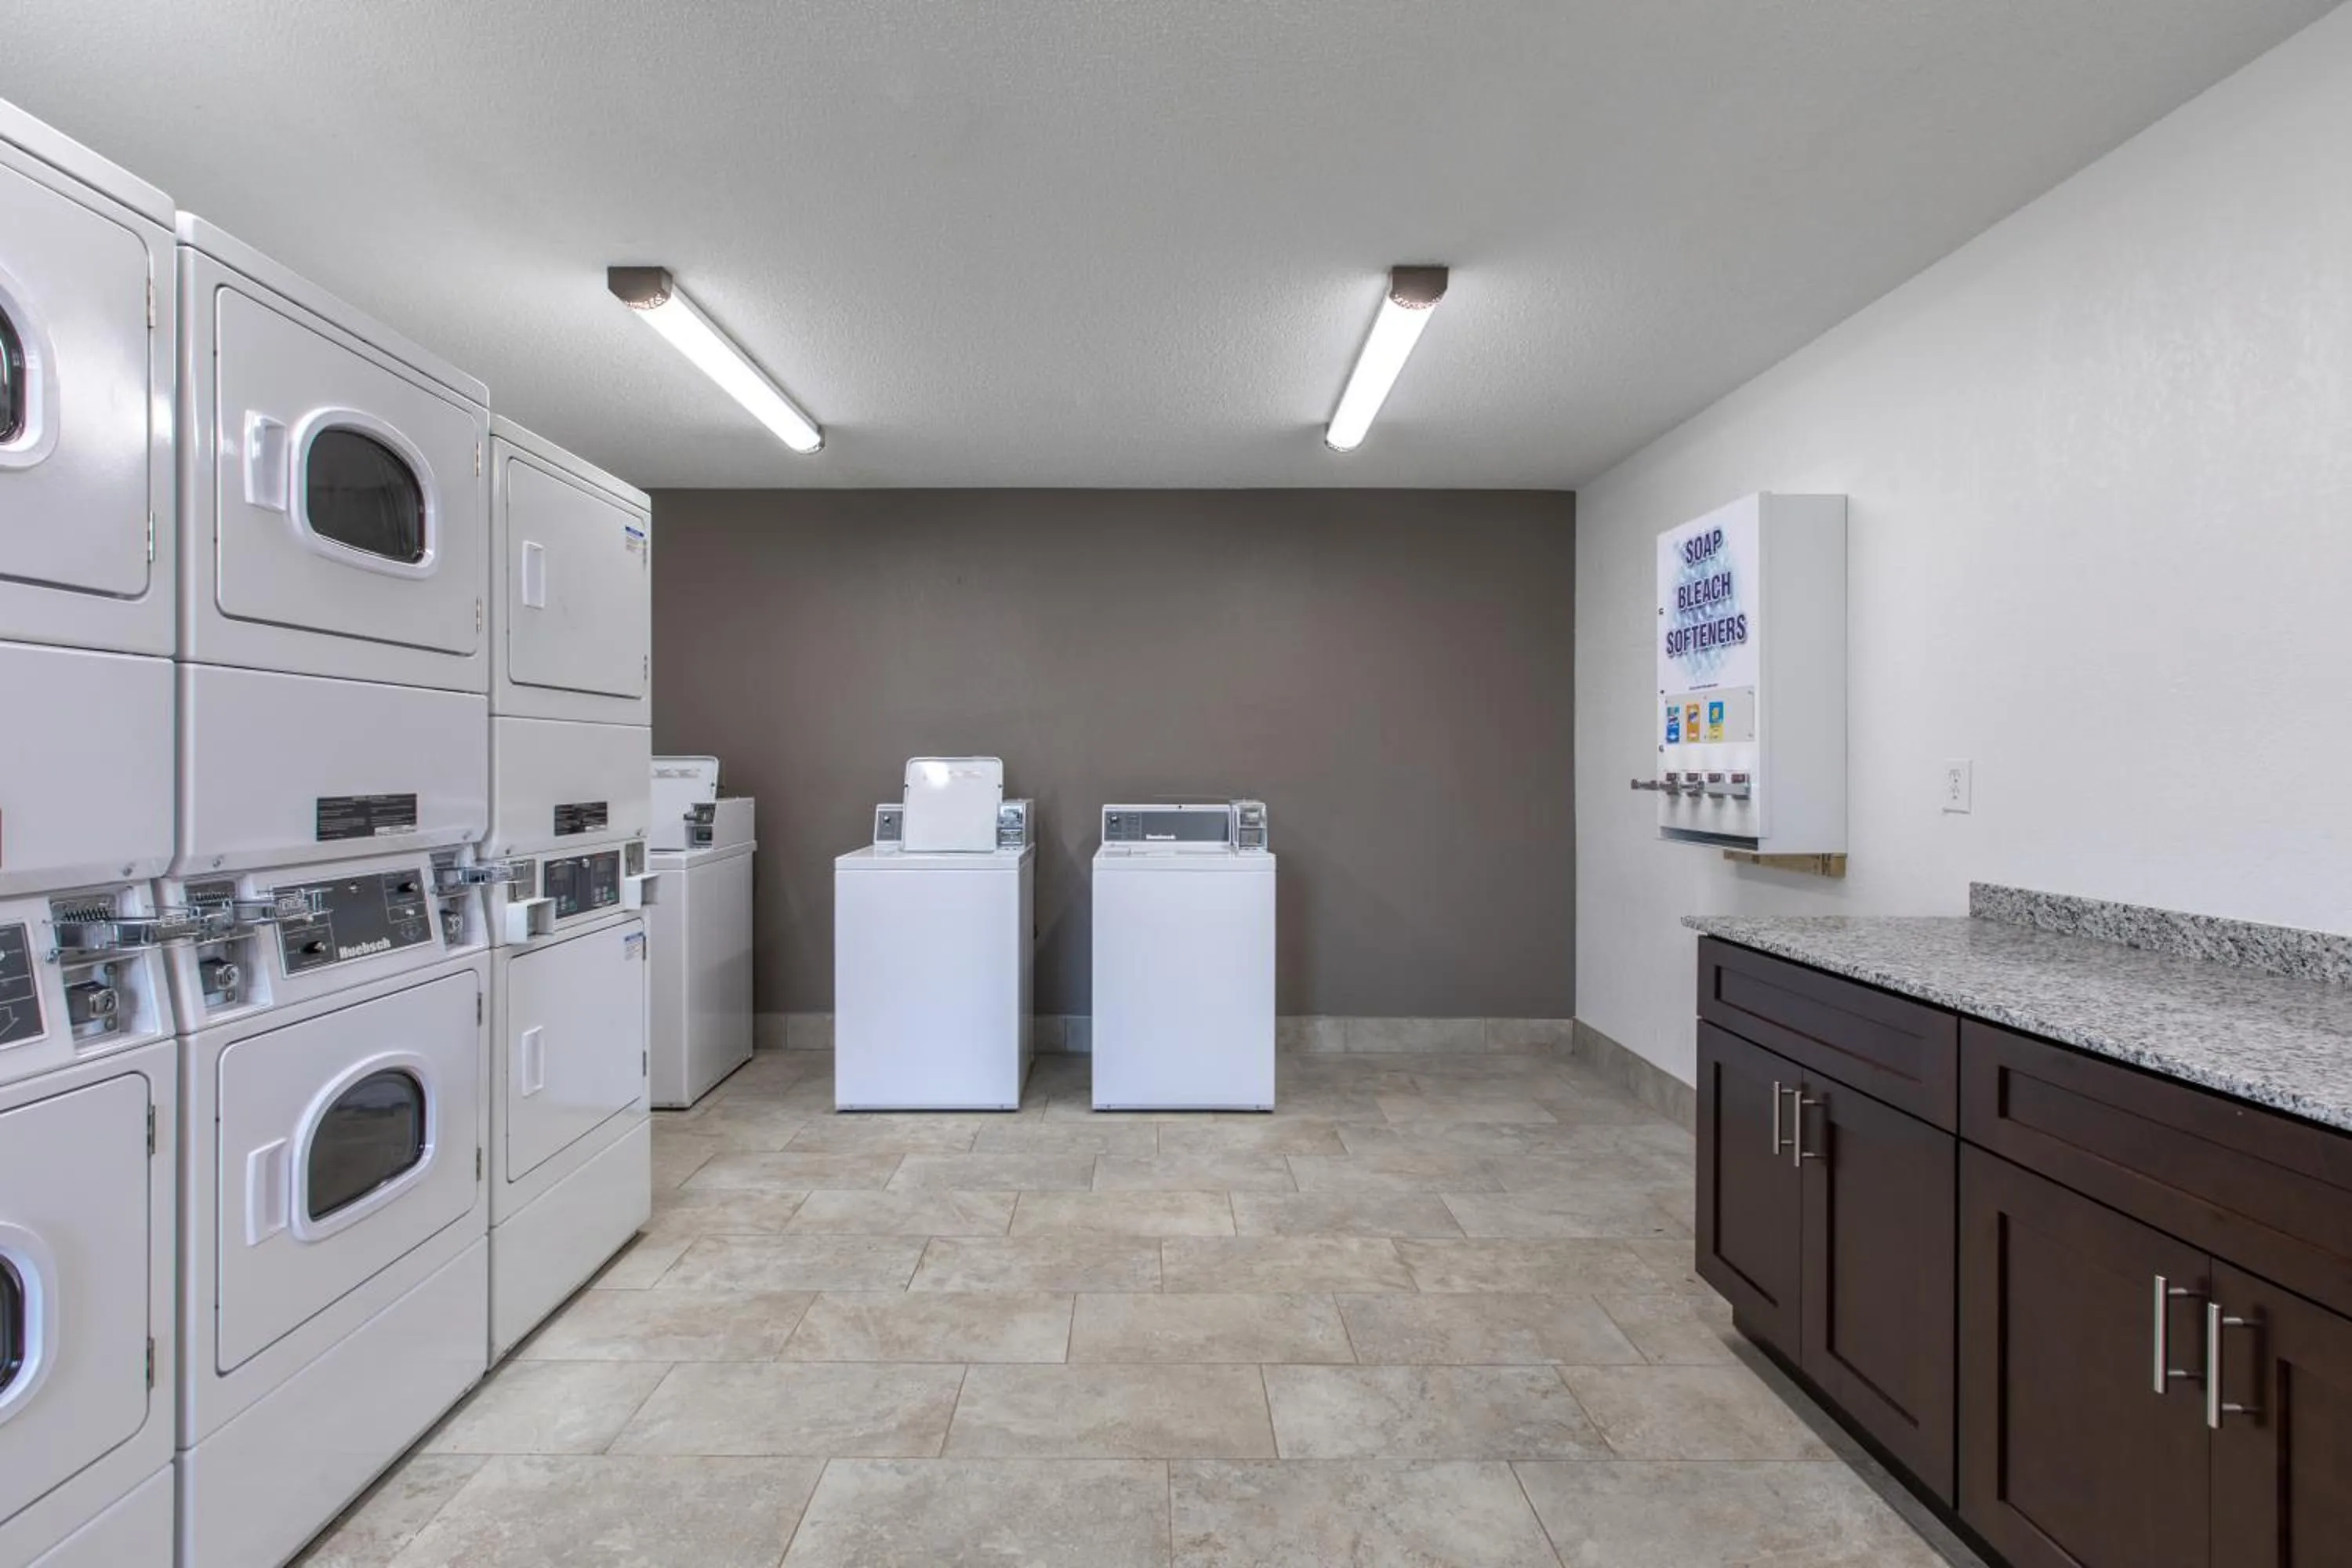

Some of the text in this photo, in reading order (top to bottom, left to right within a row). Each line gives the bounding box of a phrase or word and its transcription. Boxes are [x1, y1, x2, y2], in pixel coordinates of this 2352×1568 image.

[1686, 528, 1723, 564] SOAP
[1678, 571, 1732, 609] BLEACH
[1666, 614, 1747, 655] SOFTENERS
